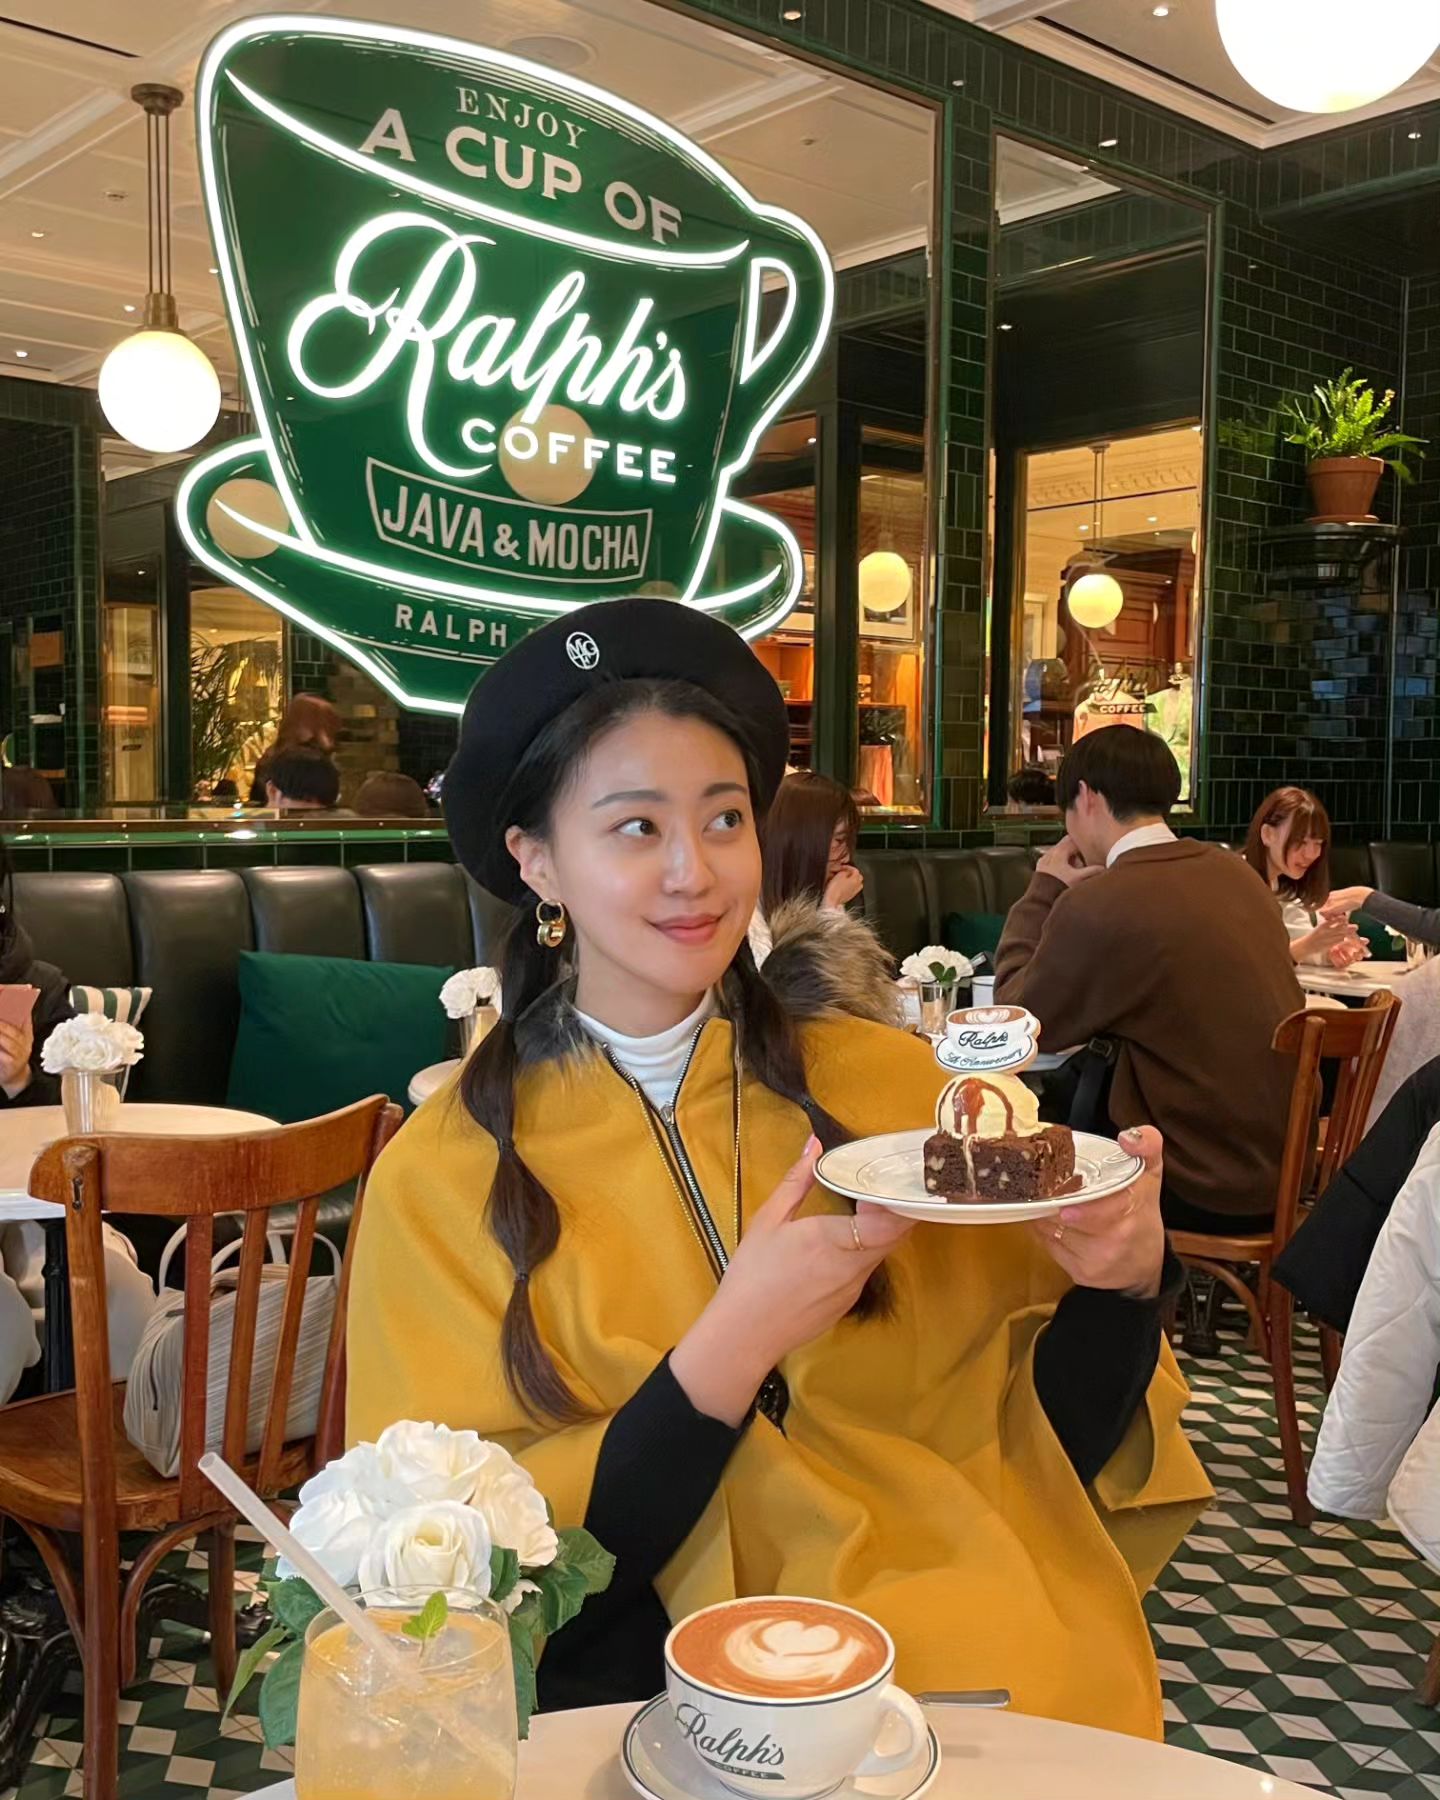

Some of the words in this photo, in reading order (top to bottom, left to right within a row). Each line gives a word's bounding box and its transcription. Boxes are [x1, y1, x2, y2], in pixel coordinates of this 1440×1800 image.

[455, 86, 587, 149] ENJOY
[358, 107, 416, 162] A
[445, 126, 583, 200] CUP
[604, 180, 683, 245] OF
[287, 211, 687, 477] Ralph's
[461, 417, 677, 484] COFFEE
[383, 485, 485, 558] JAVA
[493, 523, 521, 561] &
[527, 519, 640, 572] MOCHA
[395, 603, 508, 648] RALPH
[675, 1703, 785, 1772] Ralph's
